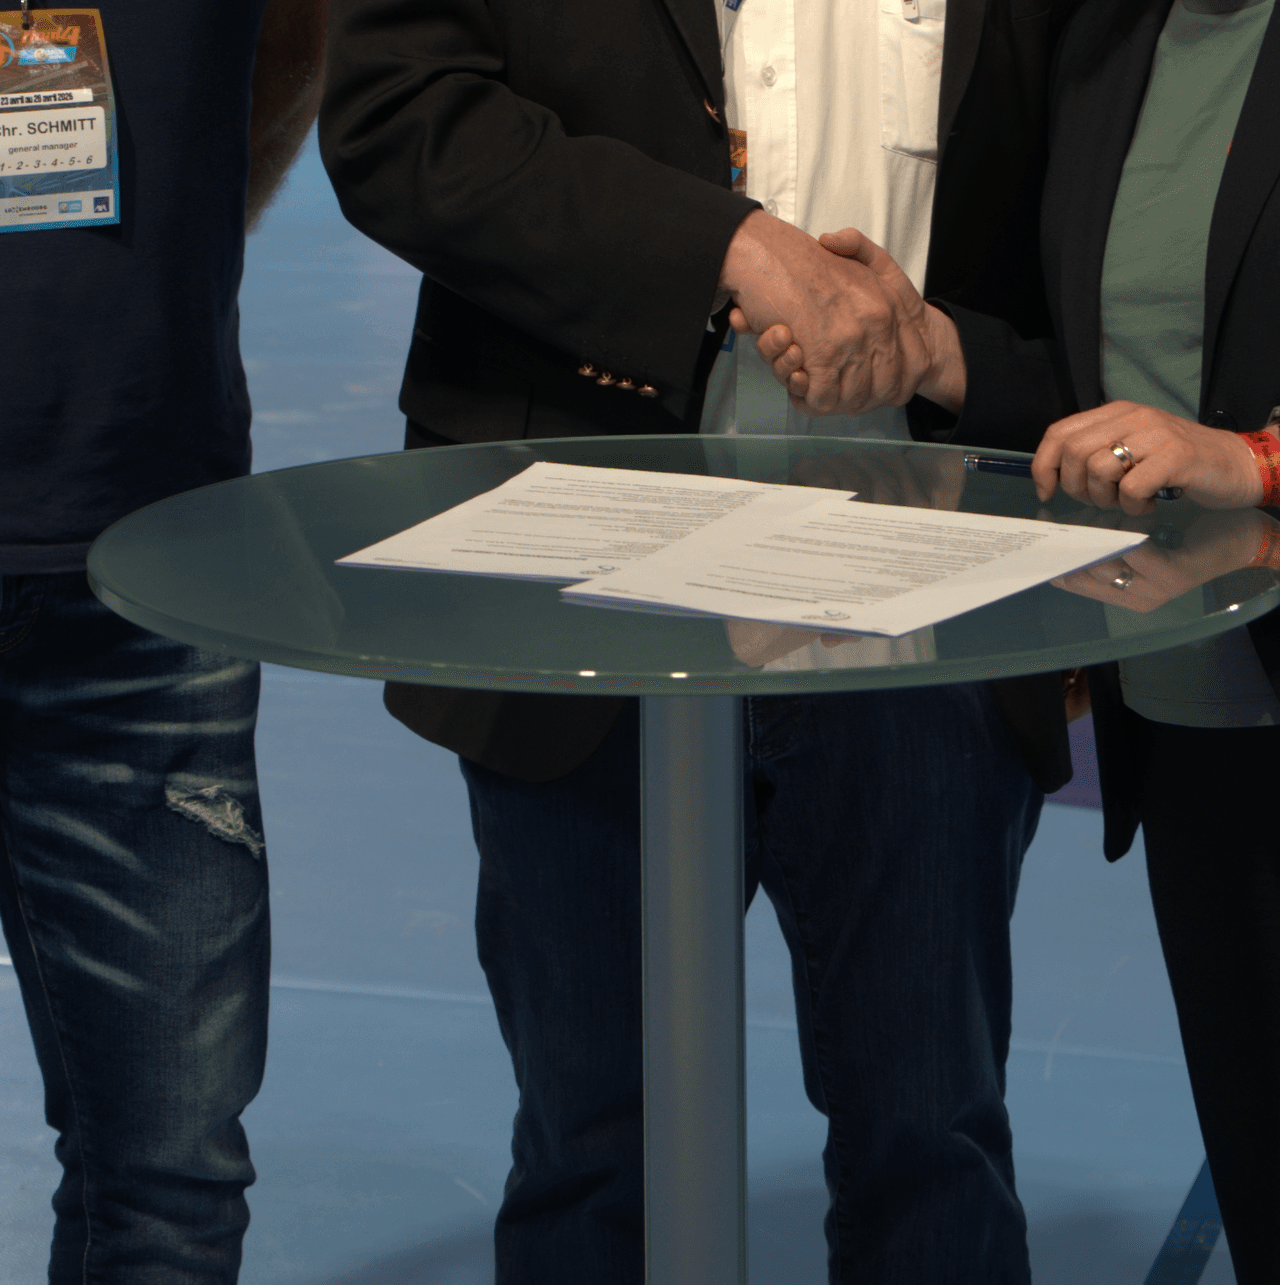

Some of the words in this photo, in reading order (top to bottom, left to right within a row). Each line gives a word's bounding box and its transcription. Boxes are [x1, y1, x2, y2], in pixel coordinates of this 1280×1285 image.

[27, 118, 96, 135] SCHMITT
[8, 145, 39, 155] general
[42, 142, 78, 151] manager
